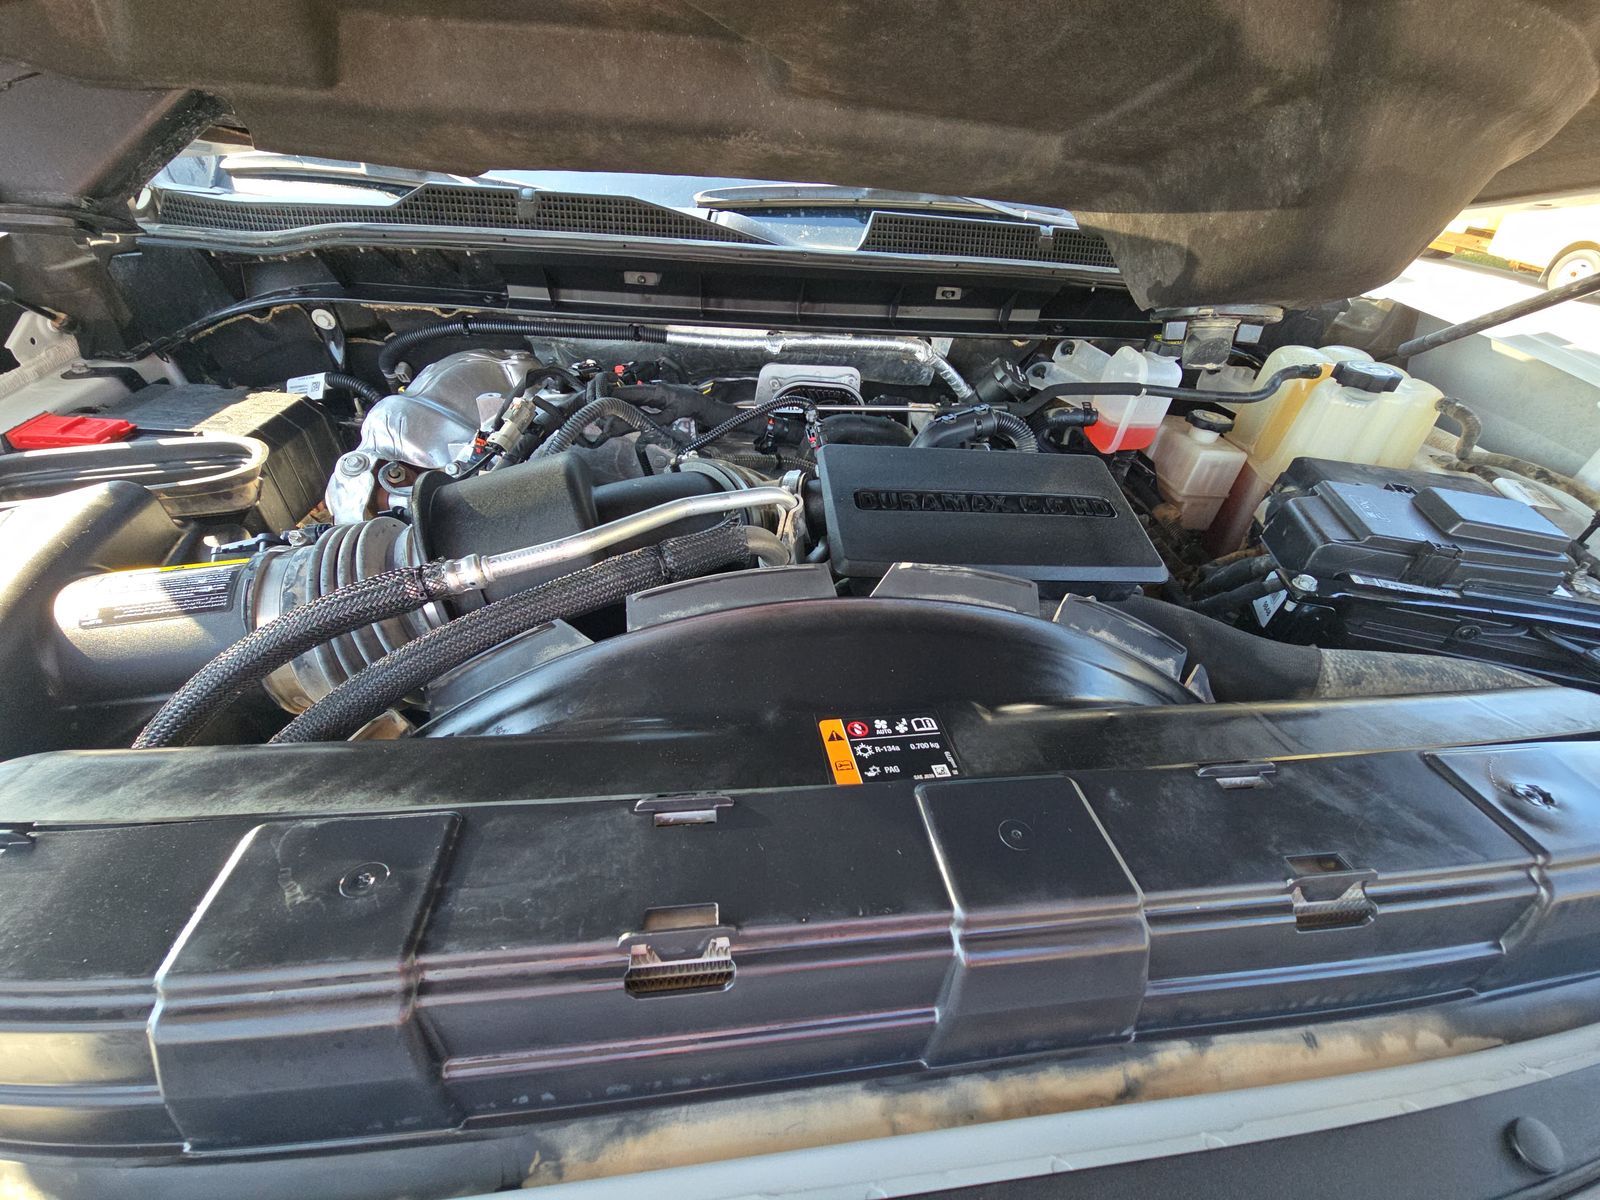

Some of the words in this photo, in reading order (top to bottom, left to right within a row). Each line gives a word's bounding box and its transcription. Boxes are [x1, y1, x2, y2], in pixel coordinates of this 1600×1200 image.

[858, 491, 1011, 513] DURAMAX
[1070, 498, 1113, 517] HD
[929, 742, 940, 750] kg
